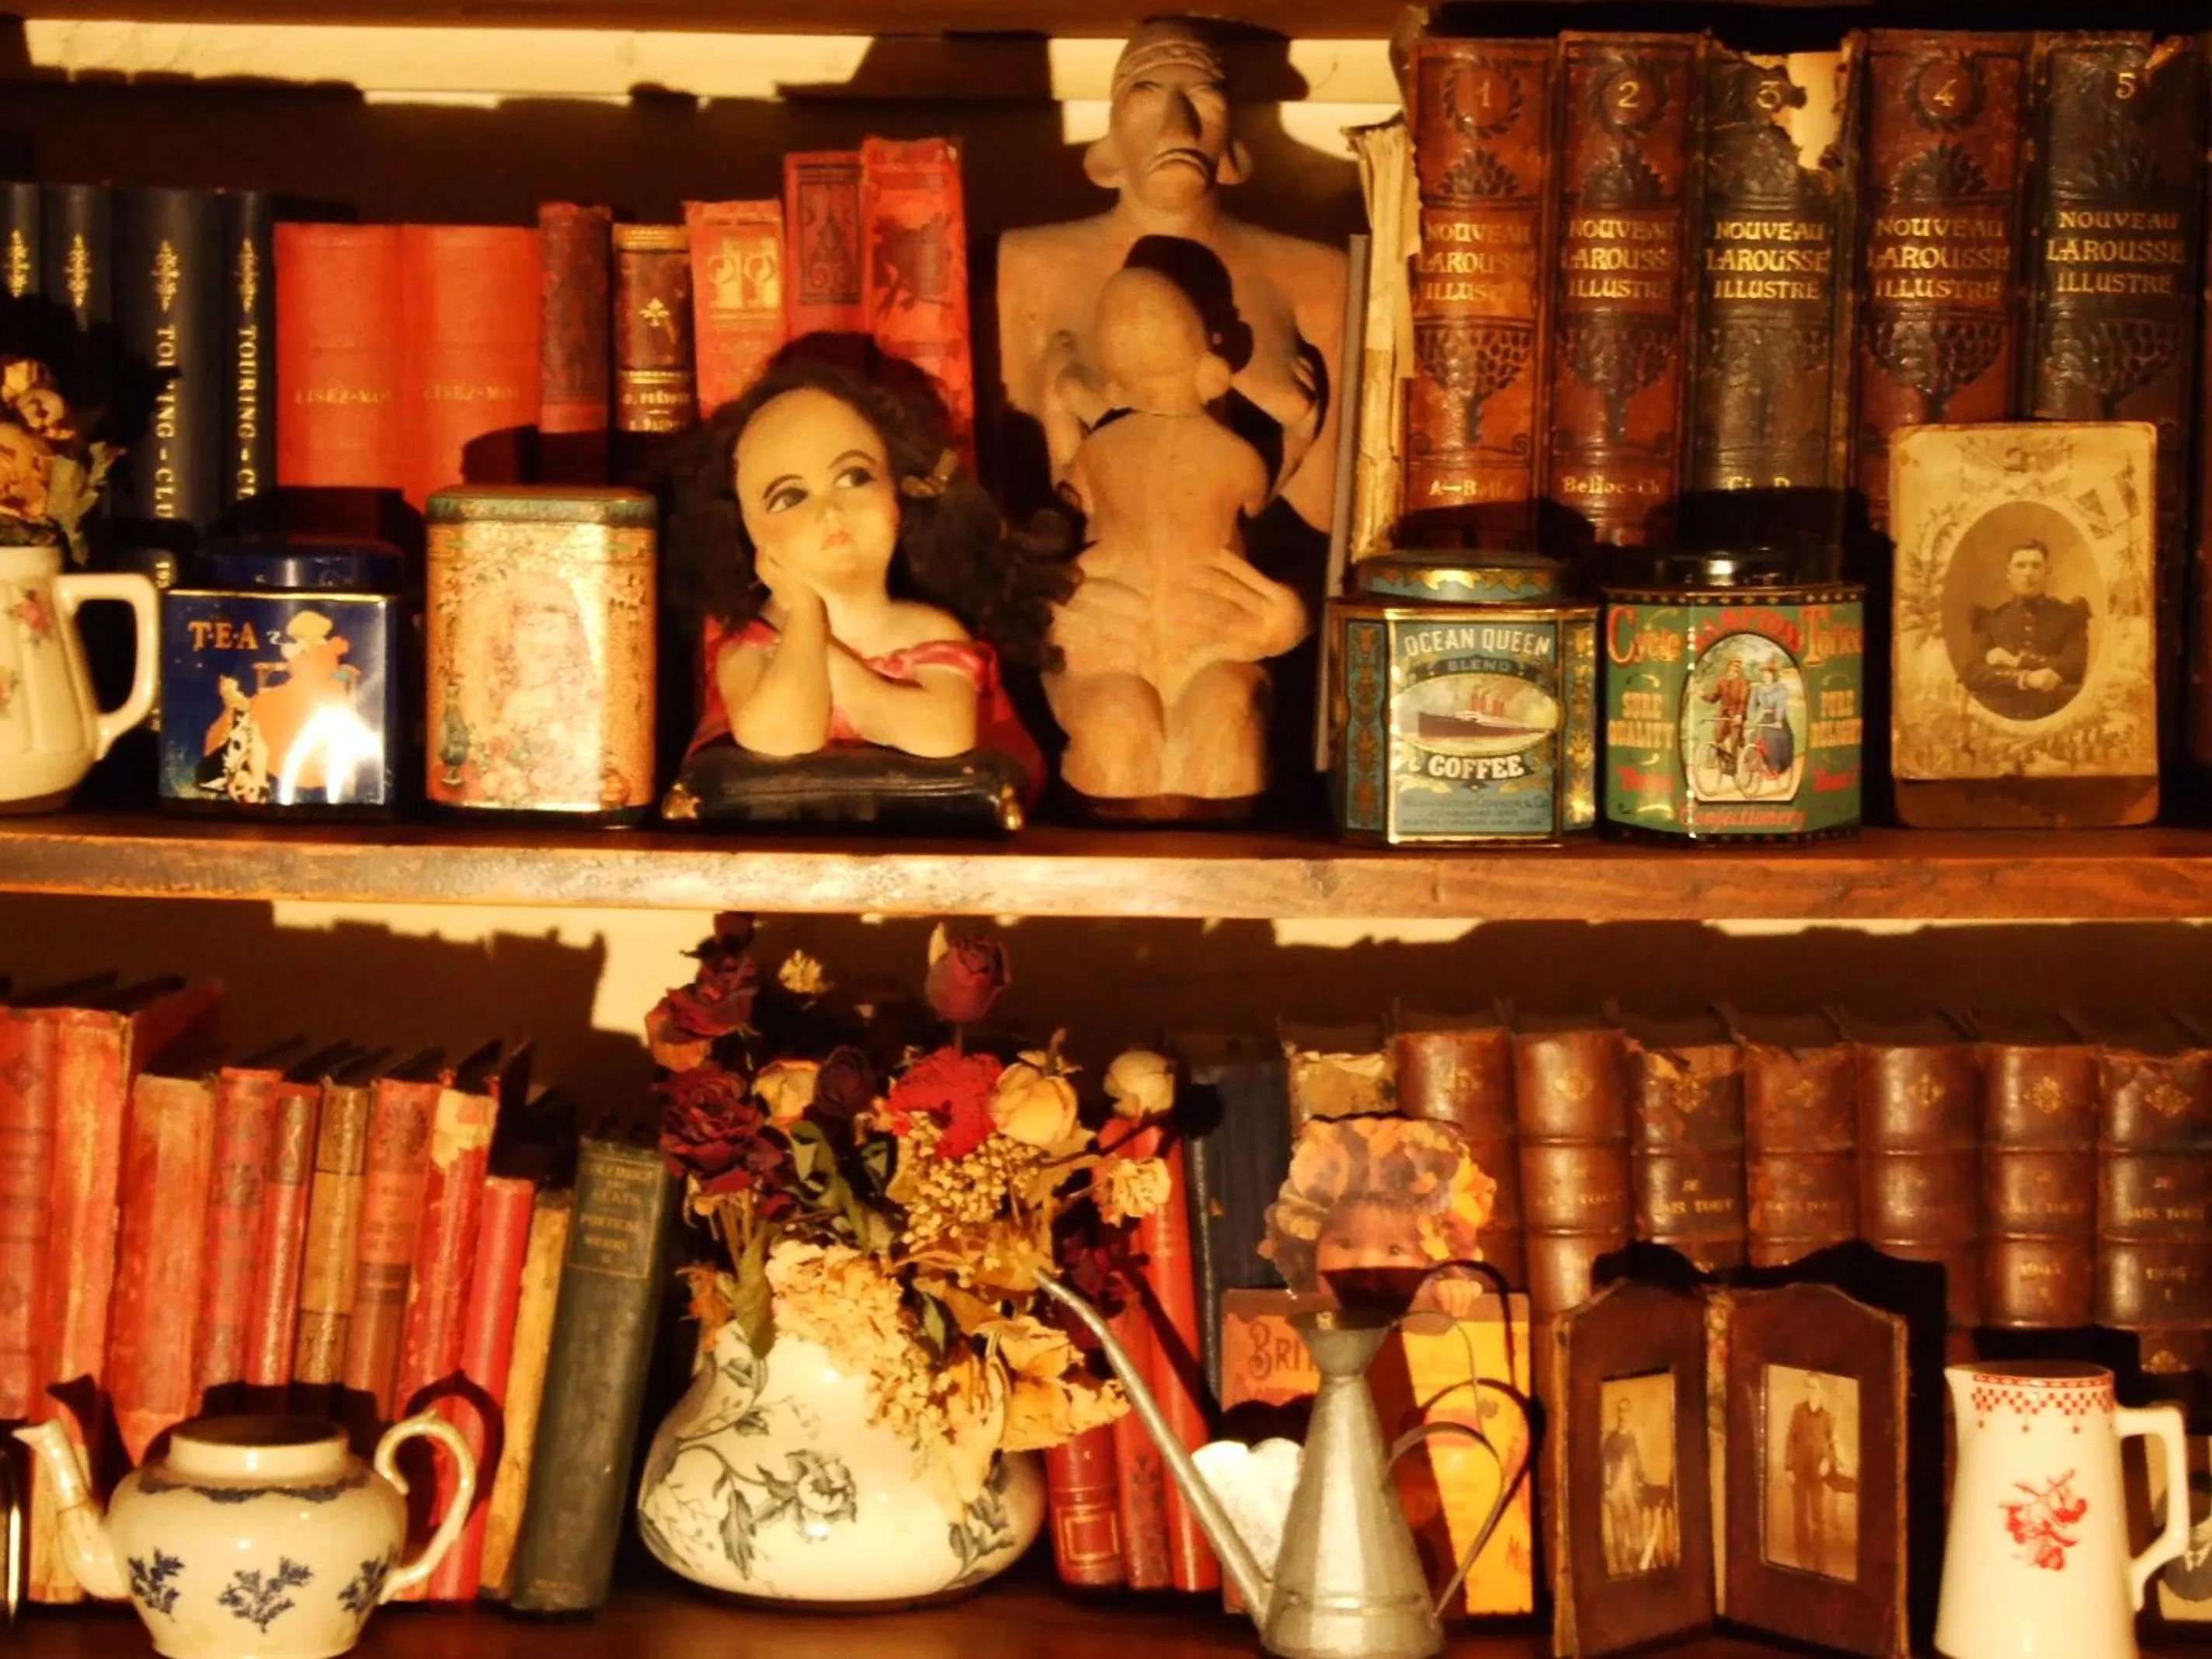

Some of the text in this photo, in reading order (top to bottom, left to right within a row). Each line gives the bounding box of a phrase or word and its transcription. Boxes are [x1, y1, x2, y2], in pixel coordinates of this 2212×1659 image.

[1477, 79, 1493, 110] 1
[1617, 80, 1641, 109] 2
[1756, 80, 1781, 110] 3
[1932, 78, 1957, 108] 4
[2115, 72, 2138, 99] 5
[1714, 221, 1826, 242] NOUVEAU
[1875, 217, 2003, 238] NOUVEAU
[2058, 210, 2178, 230] NOUVEAU
[1705, 247, 1831, 273] LAROUSSE
[1866, 244, 2011, 270] LAROUSSE
[2046, 238, 2186, 264] LAROUSSE
[237, 324, 258, 440] TOURING
[1403, 628, 1552, 658] OCEAN QUEEN
[1446, 659, 1511, 673] BLEND
[1428, 754, 1525, 779] COFFEE
[1248, 1320, 1314, 1382] BRI
